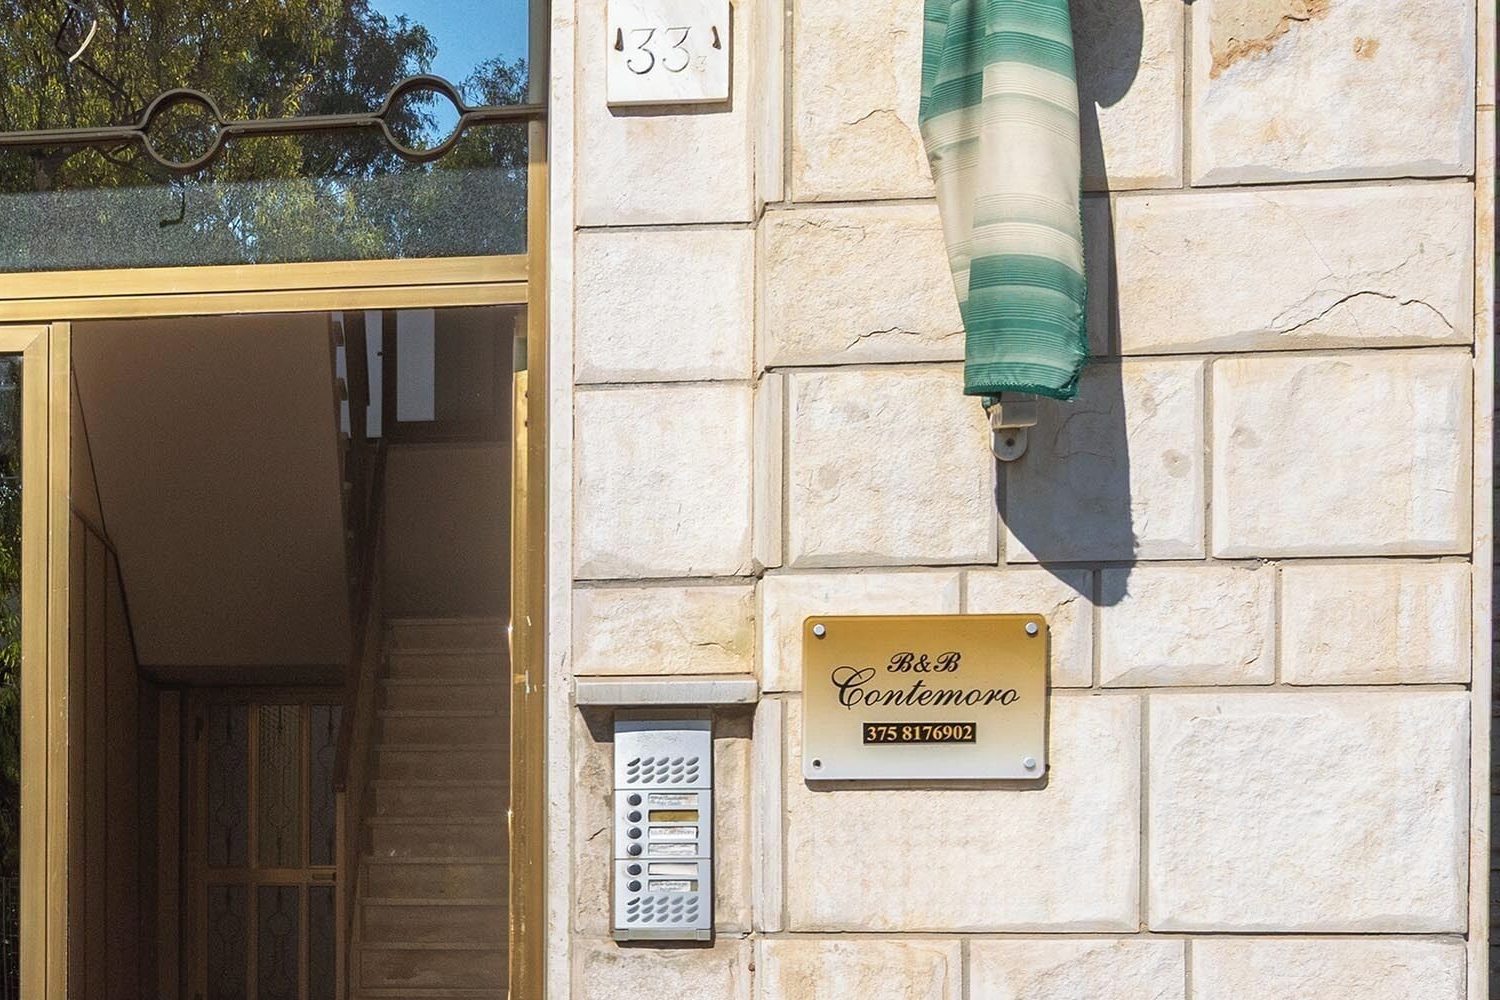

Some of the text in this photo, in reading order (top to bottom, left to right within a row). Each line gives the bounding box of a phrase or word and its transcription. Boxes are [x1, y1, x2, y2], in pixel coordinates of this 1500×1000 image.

[626, 26, 692, 75] 33
[886, 651, 962, 673] B&B
[831, 665, 1021, 710] Contemoro
[866, 725, 973, 741] 375 8176902
